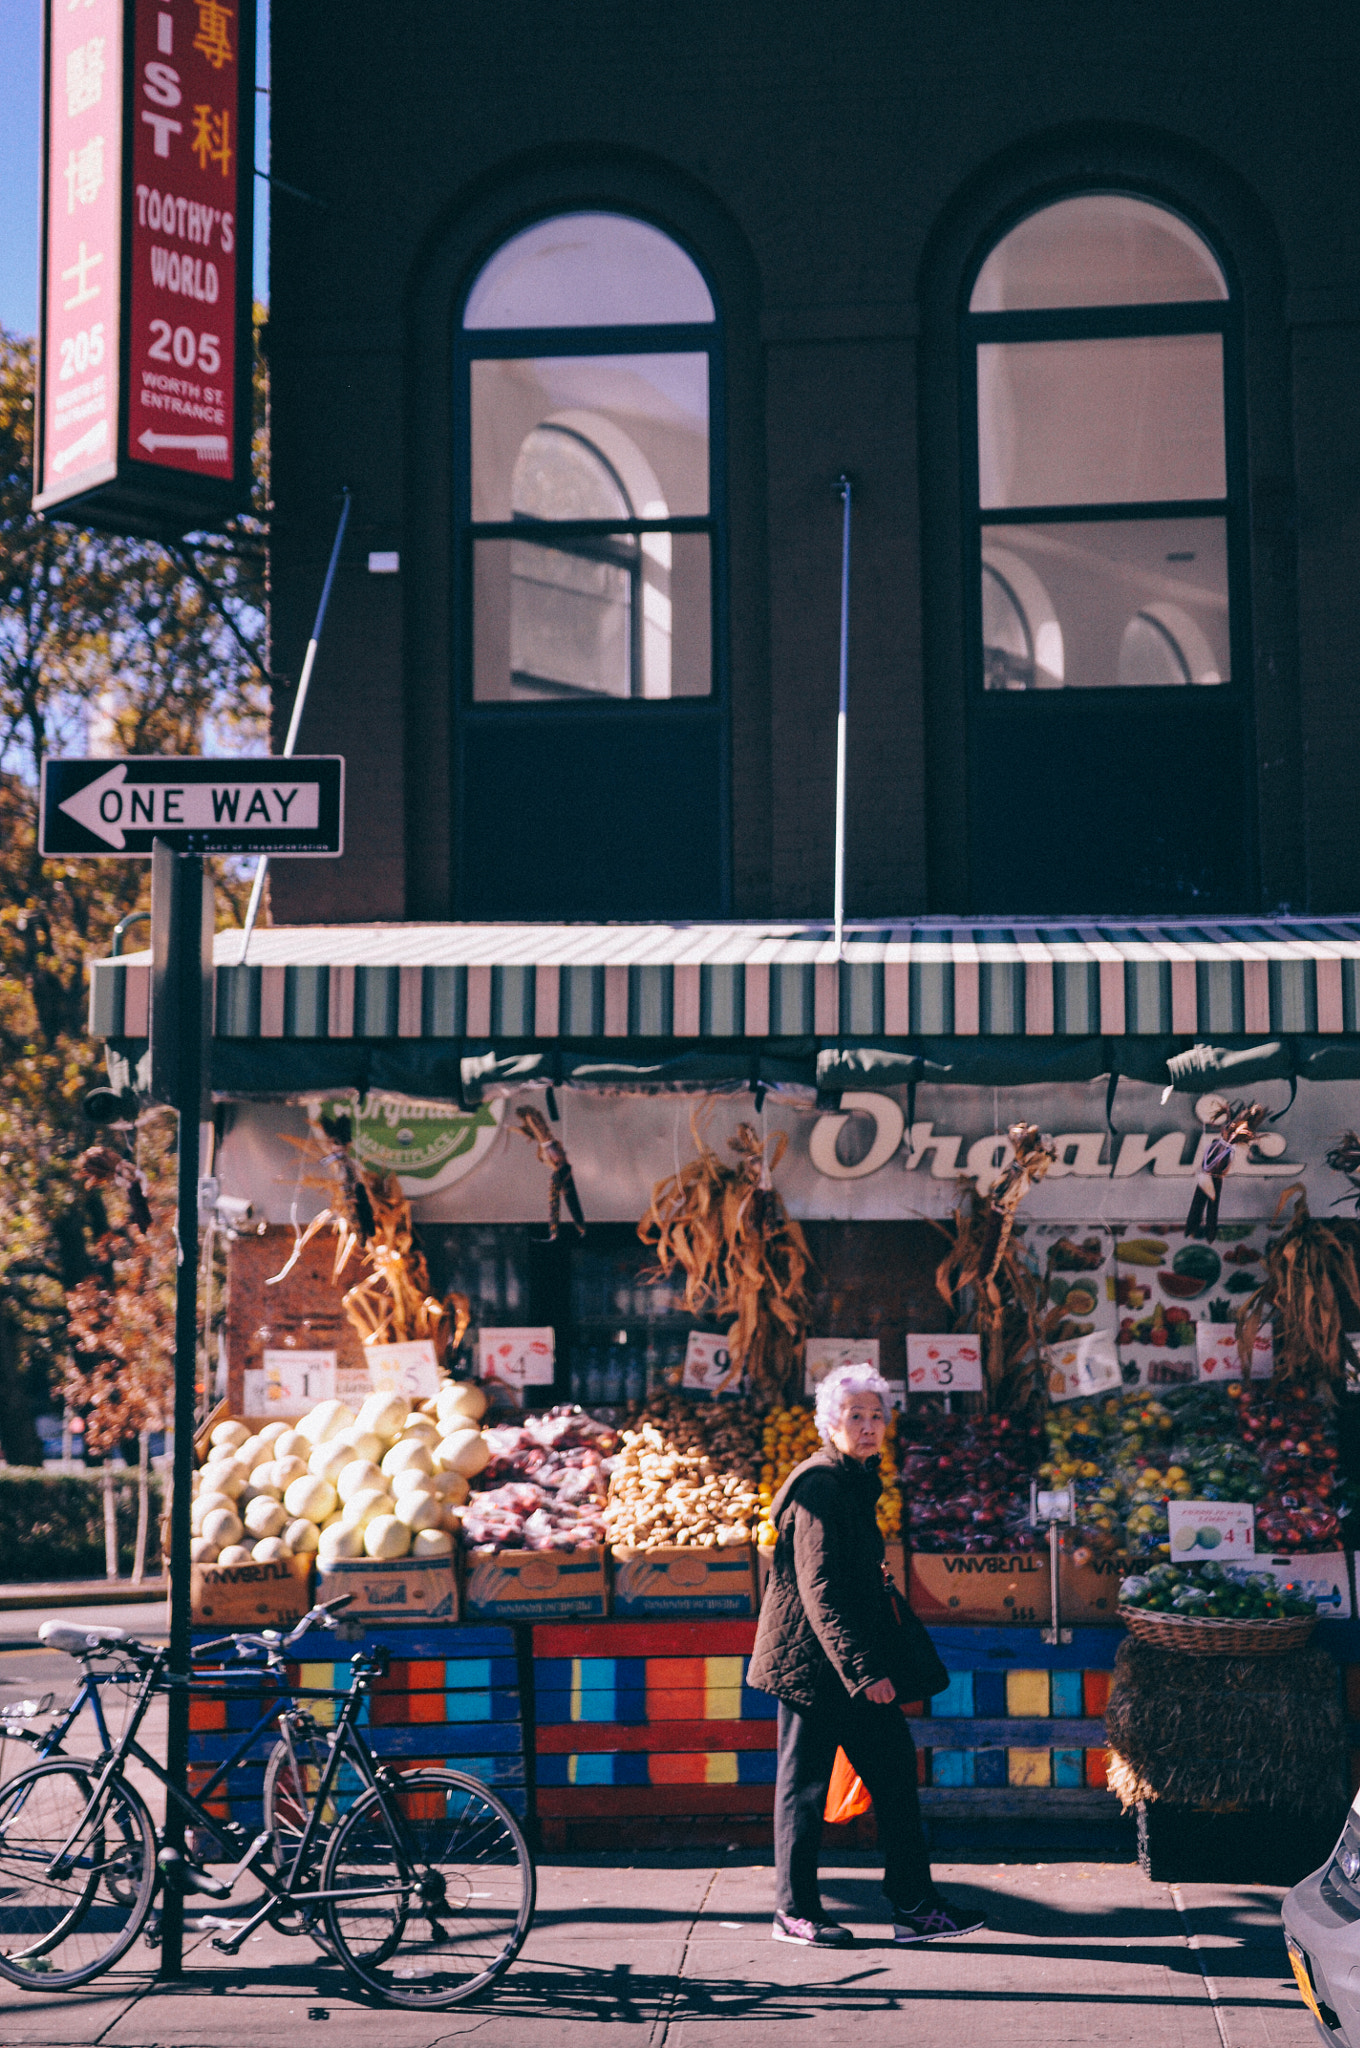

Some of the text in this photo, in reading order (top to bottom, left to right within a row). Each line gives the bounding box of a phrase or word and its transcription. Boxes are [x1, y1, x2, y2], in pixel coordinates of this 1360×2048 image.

[142, 0, 183, 158] IST
[61, 0, 106, 310] 醫博士
[136, 184, 234, 254] TOOTHY'S
[151, 245, 219, 304] WORLD
[58, 322, 105, 381] 205
[149, 318, 221, 374] 205
[140, 388, 226, 427] ENTRANCE
[141, 370, 201, 402] WORTH
[99, 788, 299, 823] ONE WAY
[713, 1348, 733, 1377] 9
[942, 1556, 1039, 1574] TURBANA
